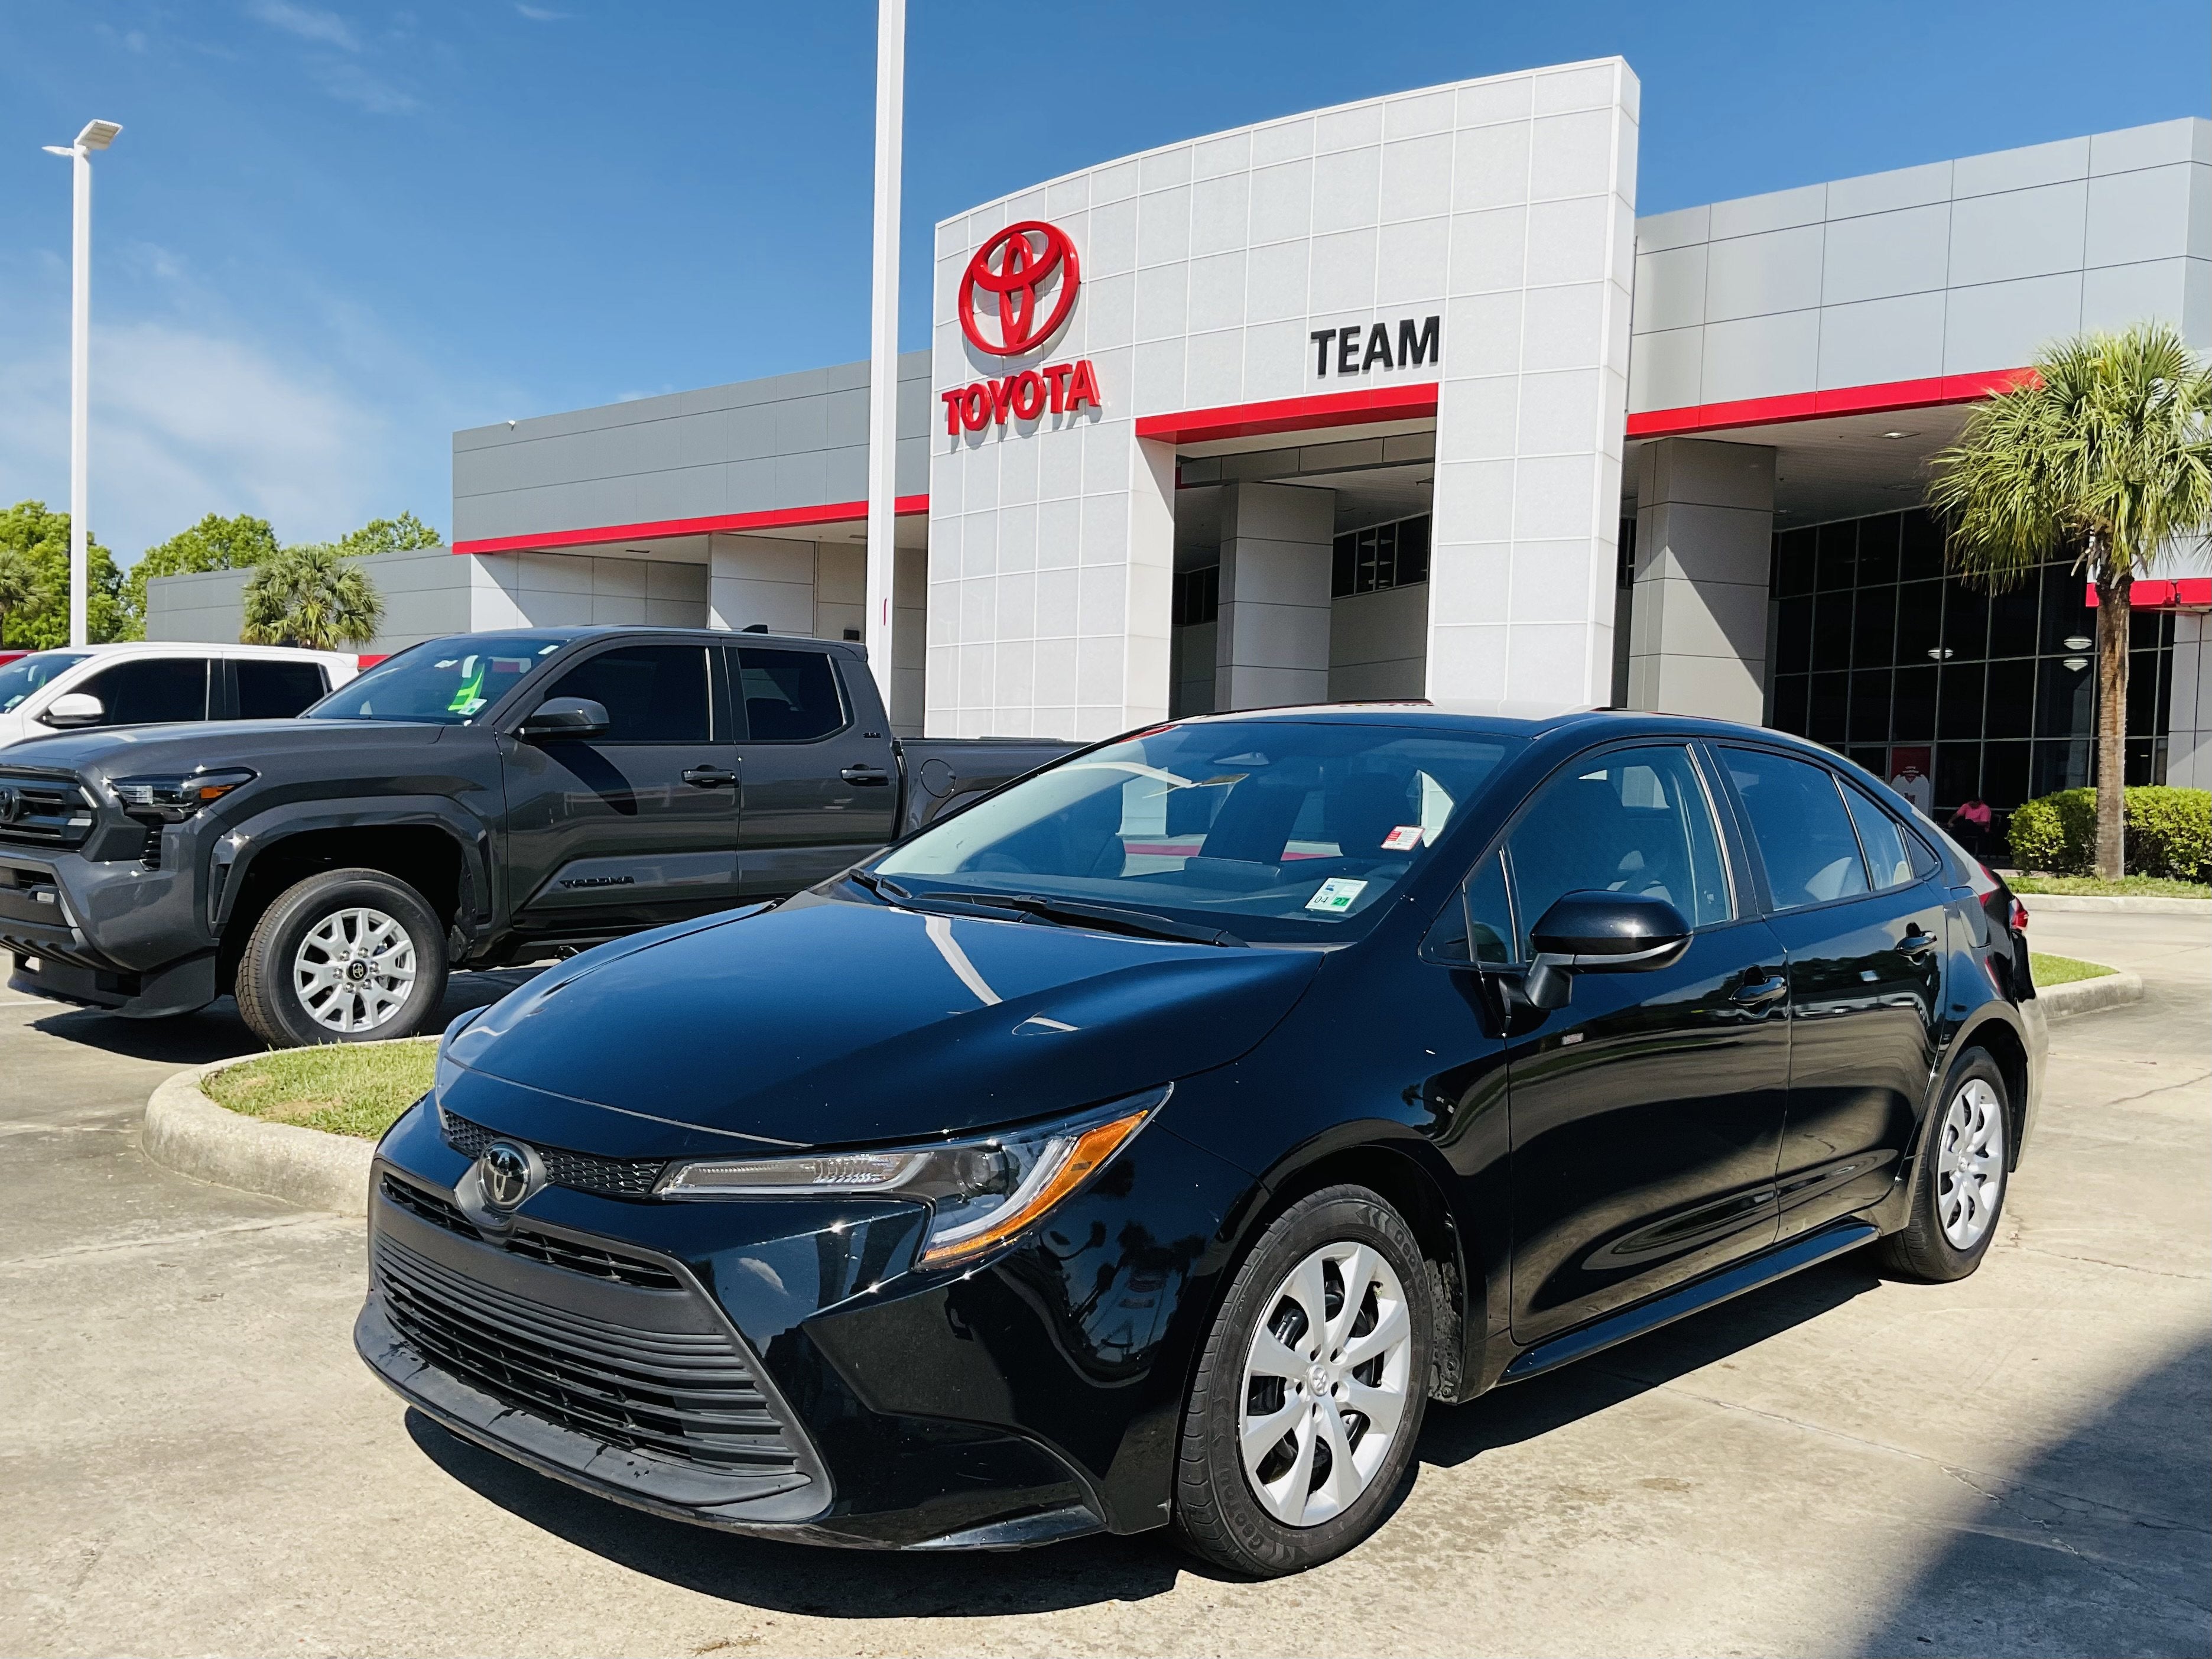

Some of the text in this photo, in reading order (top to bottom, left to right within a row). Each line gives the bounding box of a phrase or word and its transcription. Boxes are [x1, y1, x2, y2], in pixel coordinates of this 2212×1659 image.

[1311, 316, 1440, 375] TEAM
[941, 359, 1102, 435] TOYOTA
[1333, 897, 1350, 906] 27
